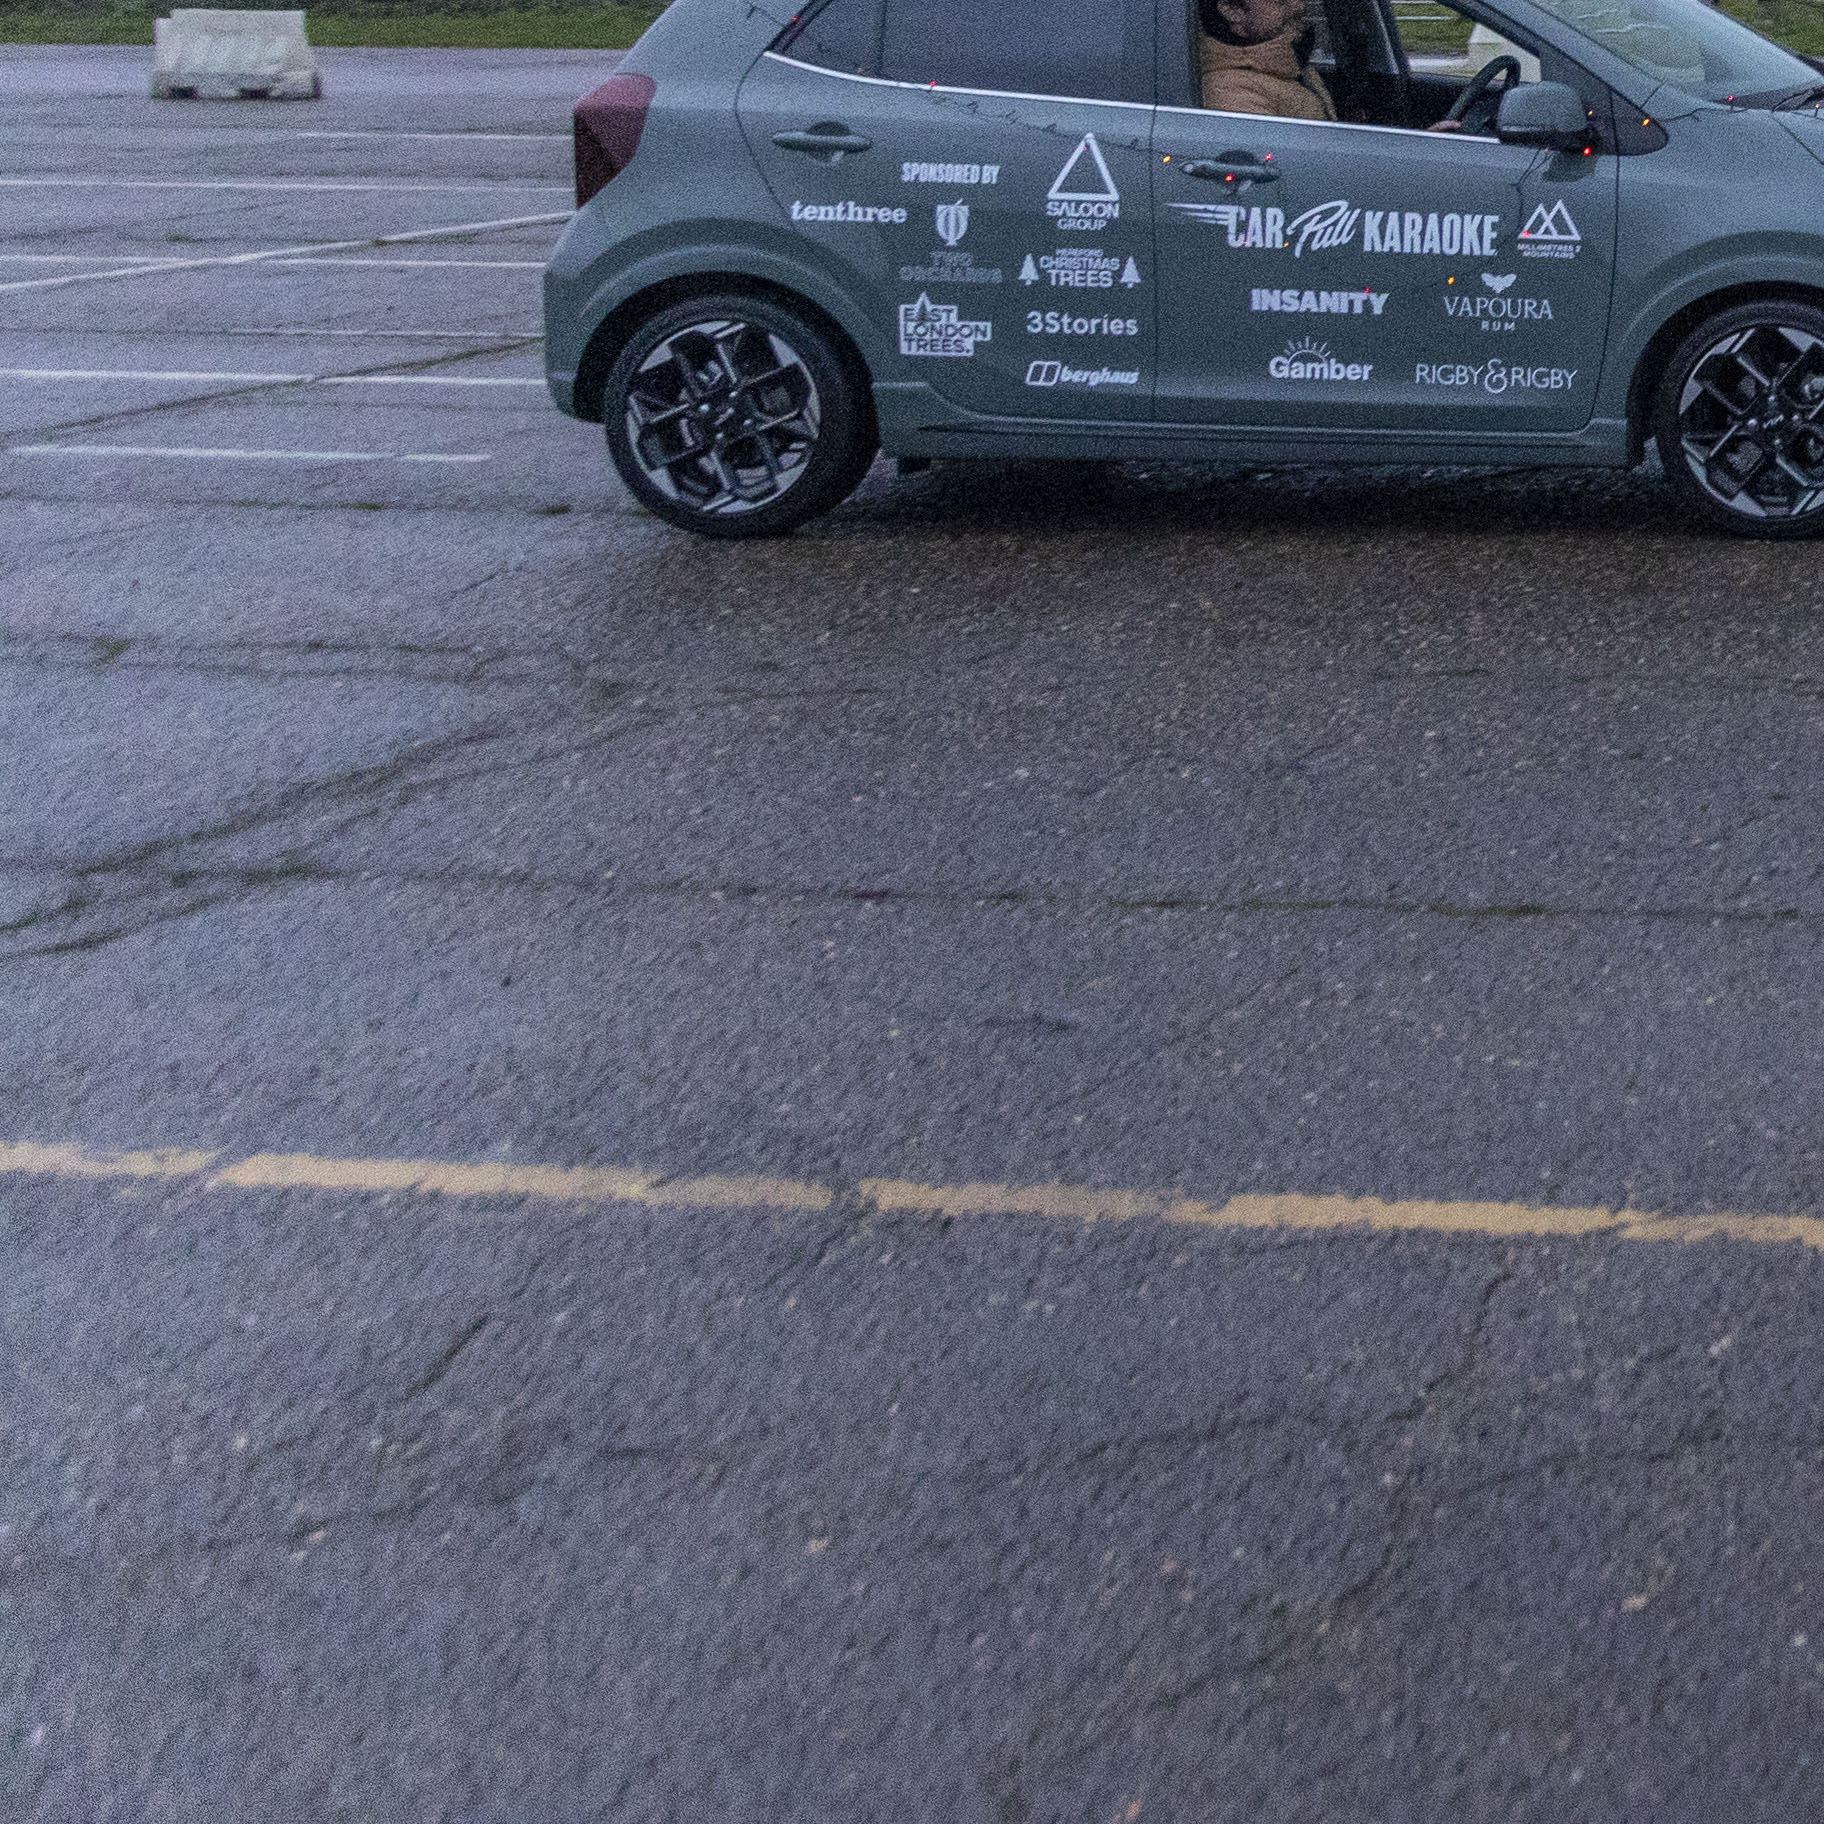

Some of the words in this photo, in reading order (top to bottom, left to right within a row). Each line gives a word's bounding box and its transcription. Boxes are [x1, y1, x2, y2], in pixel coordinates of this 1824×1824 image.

[902, 162, 979, 184] SPONSORED
[981, 164, 1000, 185] BY
[791, 200, 908, 224] tenthree
[1046, 202, 1119, 218] SALOON
[1057, 218, 1107, 231] GROUP
[1227, 205, 1284, 249] CAR
[1286, 200, 1361, 258] Pull
[1363, 209, 1499, 256] KARAOKE
[1039, 255, 1121, 271] CHRISTMAS
[1047, 269, 1114, 288] TREES
[1250, 288, 1389, 316] INSANITY
[1443, 295, 1553, 320] VAPOURA
[902, 323, 987, 339] LONDON
[1026, 311, 1139, 336] 3Stories
[1480, 320, 1516, 332] RUM
[1061, 366, 1140, 387] berghaus
[1268, 356, 1374, 381] Gamber
